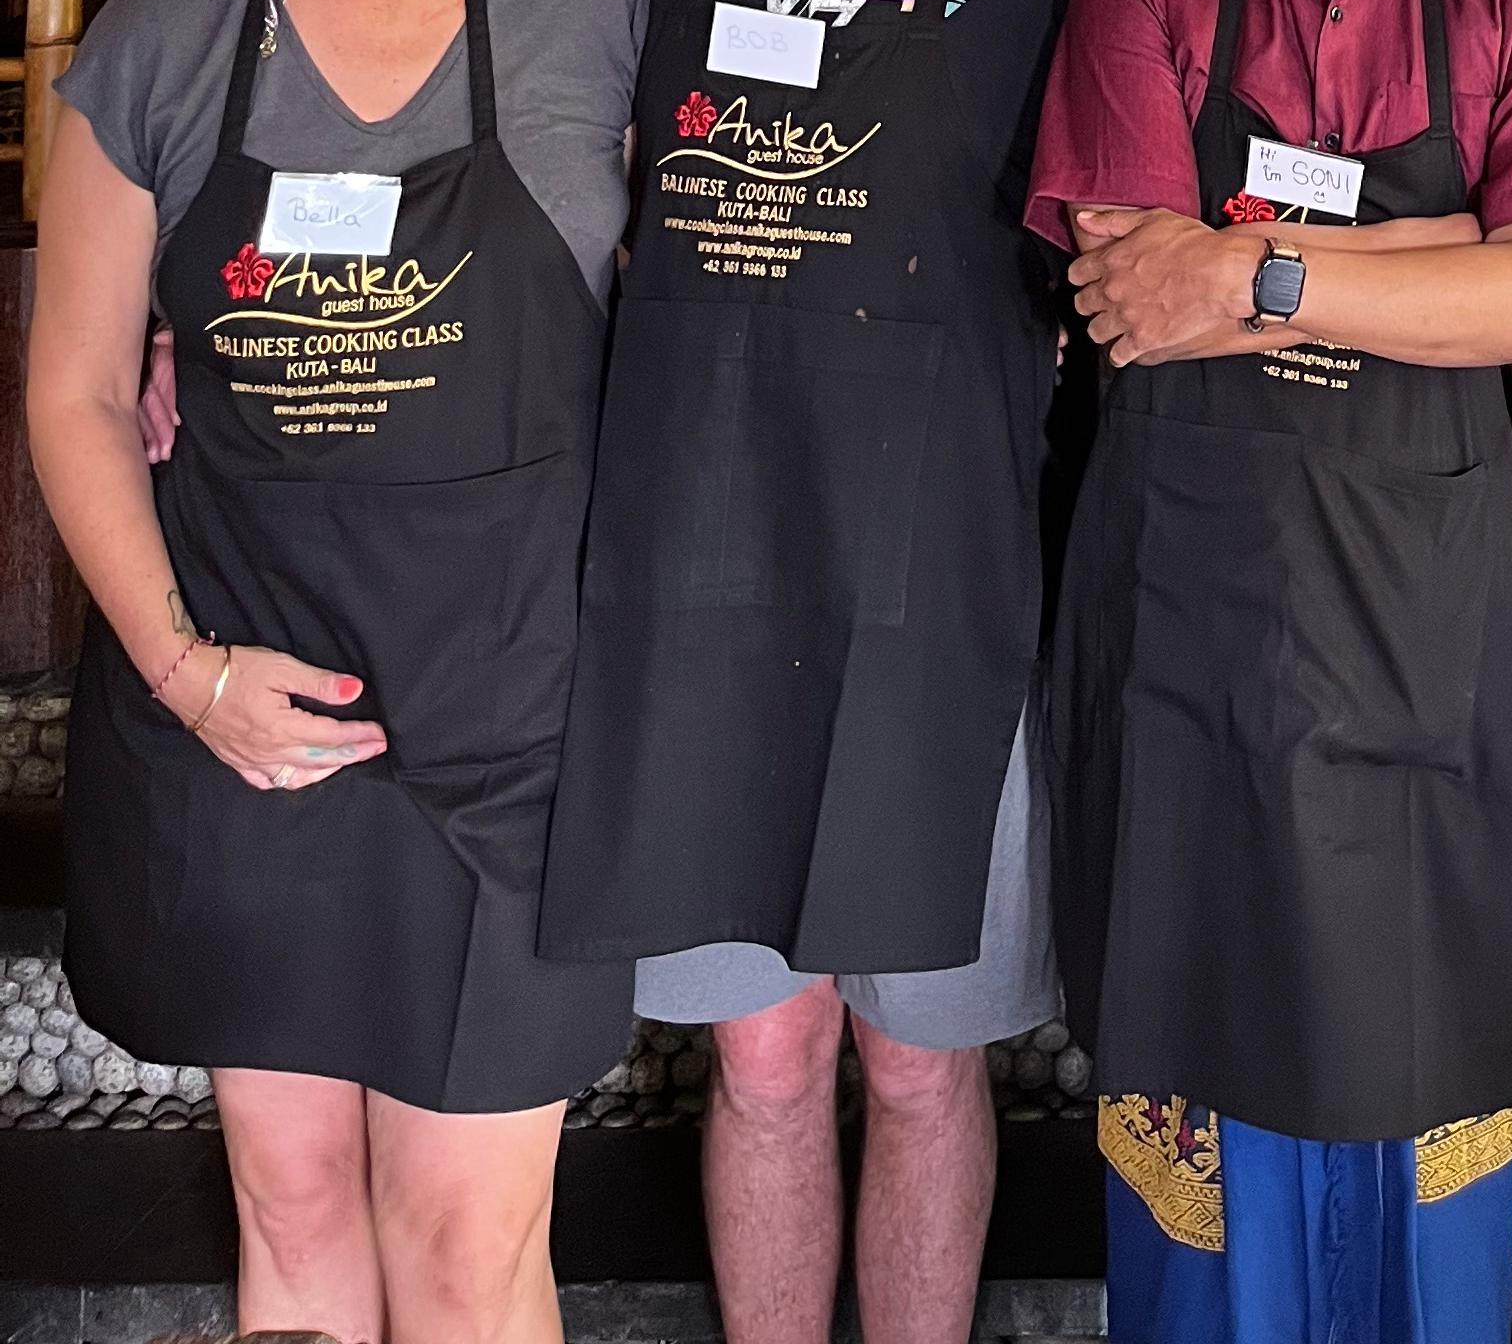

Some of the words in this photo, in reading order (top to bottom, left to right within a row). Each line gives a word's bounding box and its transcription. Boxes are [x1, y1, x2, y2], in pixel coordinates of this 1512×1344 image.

[707, 96, 847, 154] Anika
[748, 149, 782, 165] guest
[786, 148, 824, 164] house
[1261, 147, 1276, 160] Hi
[661, 173, 726, 198] BALINESE
[736, 182, 807, 205] COOKING
[817, 188, 868, 208] CLASS
[1292, 161, 1350, 194] SONI
[288, 197, 361, 227] Bella
[264, 253, 439, 303] Anika
[322, 296, 364, 316] guest
[369, 294, 415, 311] house
[214, 334, 299, 357] BALINESE
[304, 330, 397, 356] COOKING
[402, 322, 463, 347] CLASS
